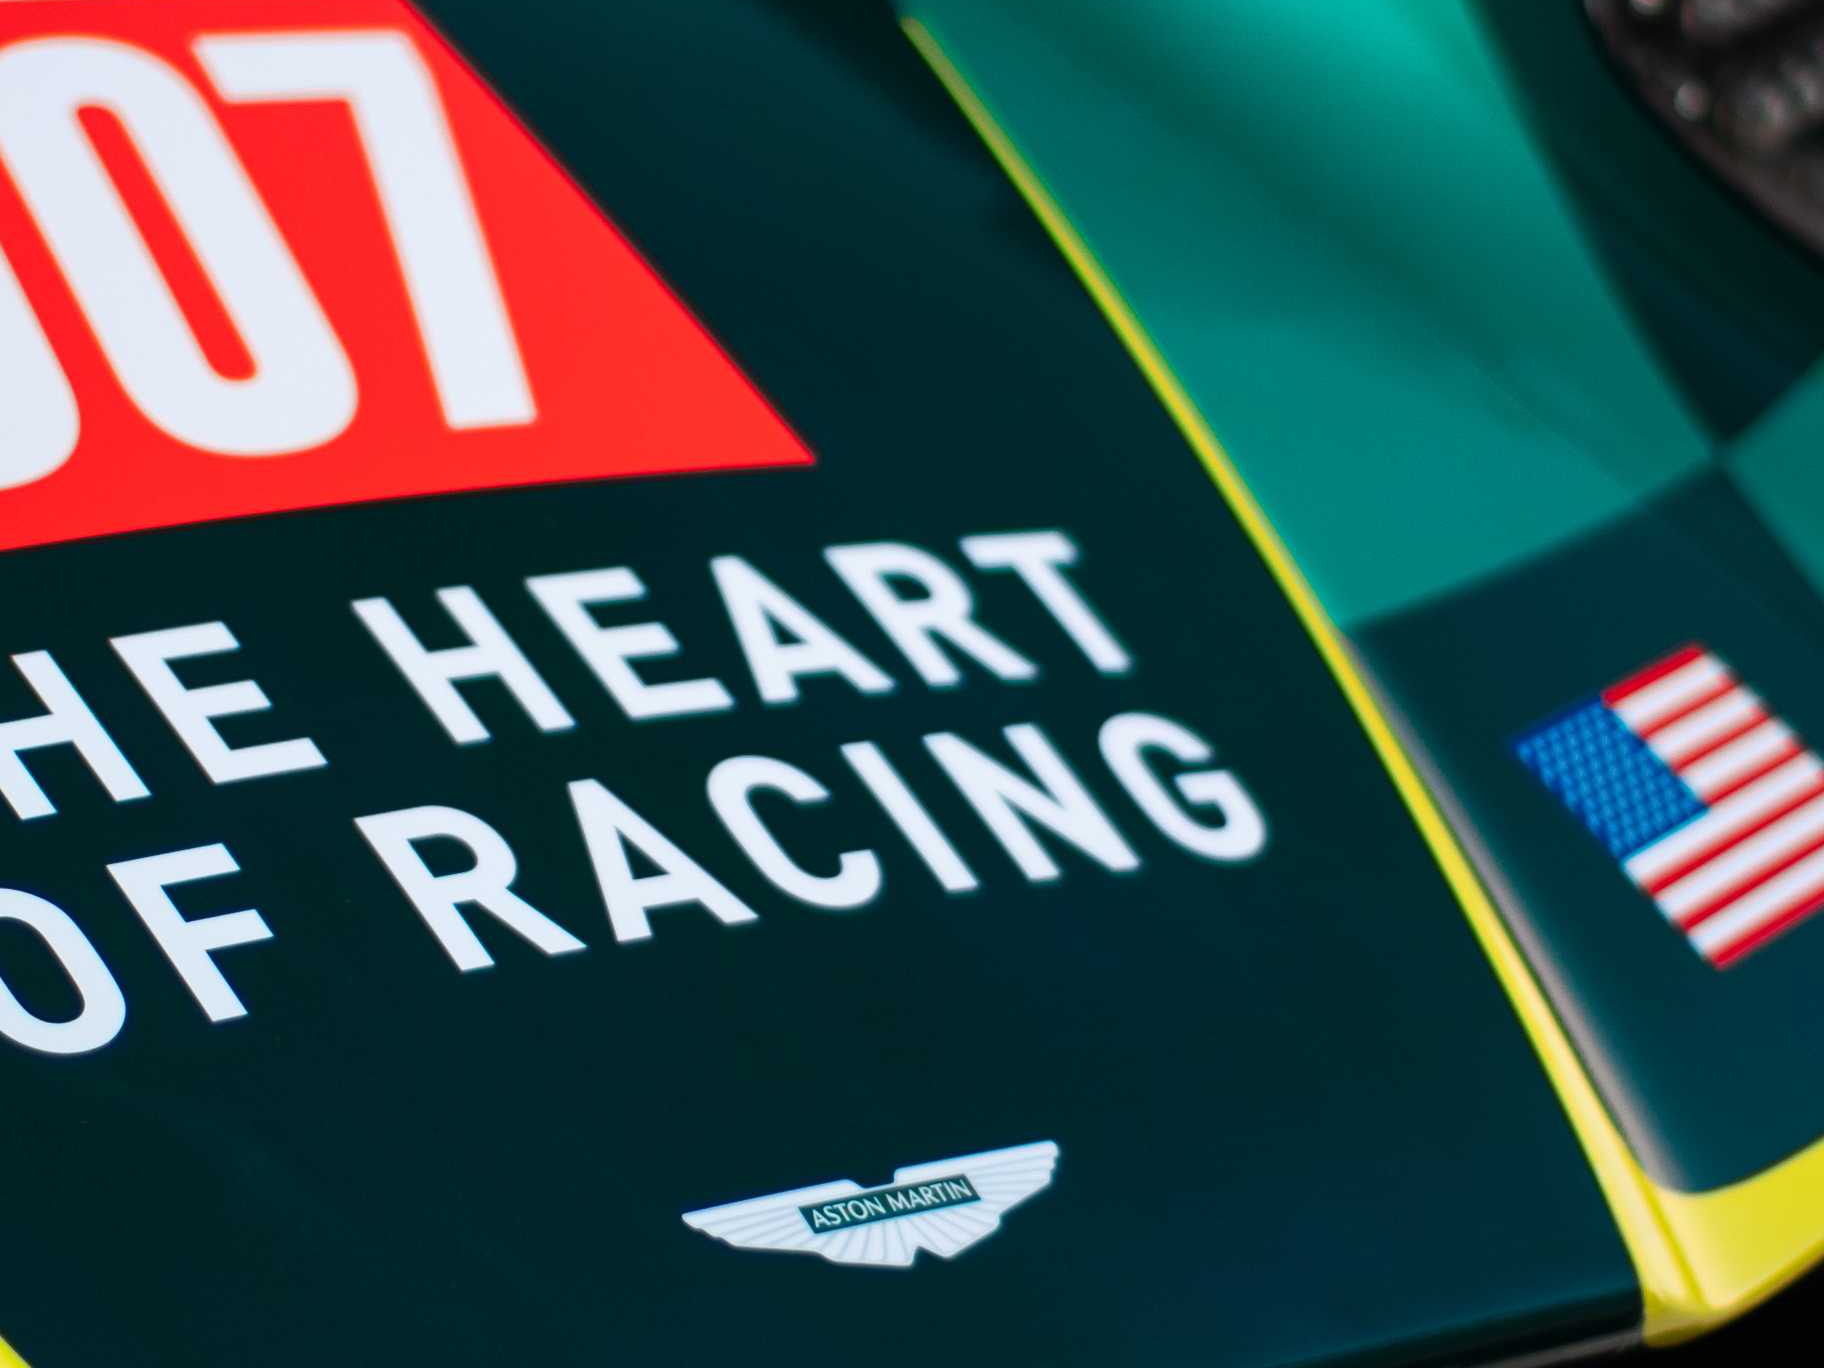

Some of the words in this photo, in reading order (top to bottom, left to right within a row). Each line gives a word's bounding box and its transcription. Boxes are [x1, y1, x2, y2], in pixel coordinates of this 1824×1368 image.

[350, 531, 1129, 745] HEART
[352, 712, 1266, 974] RACING
[812, 1195, 887, 1229] ASTON
[885, 1177, 973, 1212] MARTIN
